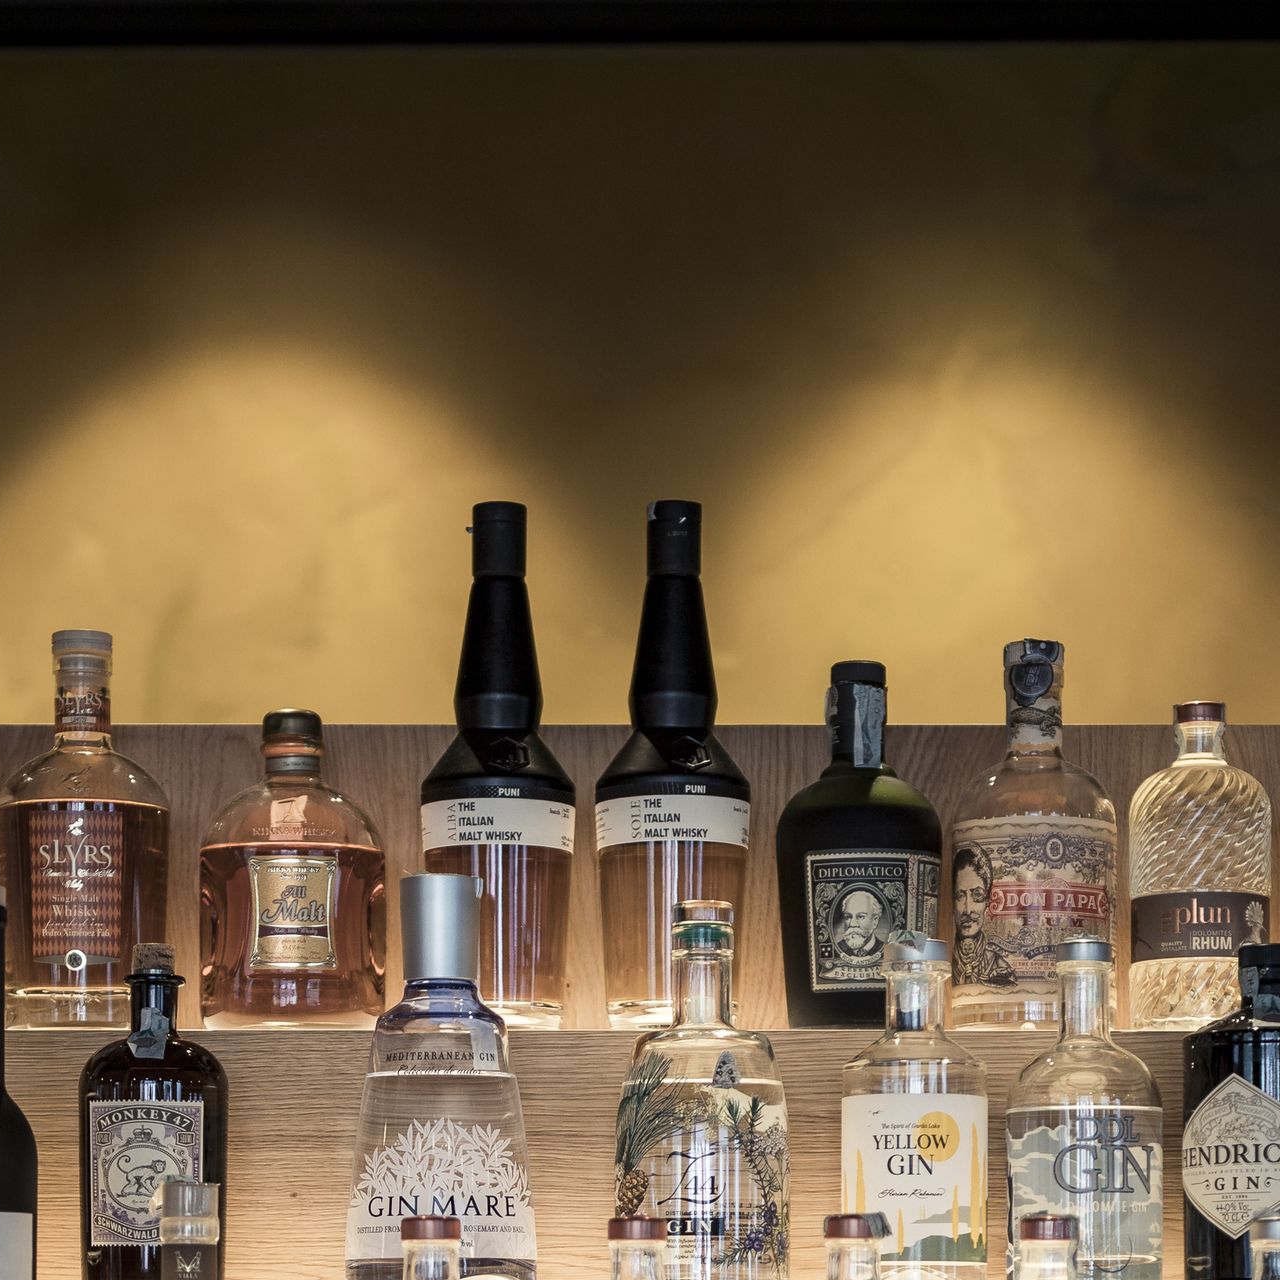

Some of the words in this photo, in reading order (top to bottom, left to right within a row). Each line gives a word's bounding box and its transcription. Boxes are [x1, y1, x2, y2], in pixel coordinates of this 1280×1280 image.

[498, 787, 520, 797] PUNI
[684, 784, 707, 794] PUNI
[458, 802, 476, 812] THE
[643, 798, 662, 808] THE
[447, 802, 458, 842] ALBA
[458, 816, 494, 827] ITALIAN
[630, 800, 642, 840] SOLE
[644, 813, 681, 824] ITALIAN
[459, 831, 483, 842] MALT
[485, 831, 523, 842] WHISKY
[644, 828, 670, 839] MALT
[672, 828, 709, 838] WHISKY
[38, 834, 113, 878] SLYRS
[818, 864, 903, 878] DIPLOMÁTICO
[280, 884, 307, 901] All
[1005, 892, 1047, 907] DON
[1052, 892, 1097, 910] PAPA
[51, 904, 99, 918] Whisky
[261, 899, 326, 925] Malt
[1173, 897, 1231, 934] plun
[1192, 929, 1233, 937] DOLOMITES
[1192, 936, 1233, 950] RHUM
[385, 1052, 475, 1063] MEDITERRANEAN
[478, 1052, 496, 1062] GIN
[100, 1107, 172, 1129] MONKEY
[172, 1114, 192, 1127] 47
[1075, 1114, 1141, 1144] DOL
[872, 1133, 951, 1151] YELLOW
[886, 1153, 935, 1177] GIN
[1052, 1143, 1155, 1195] GIN
[1214, 1175, 1261, 1191] GIN
[368, 1194, 420, 1218] GIN
[431, 1194, 517, 1219] MARE
[1131, 1201, 1147, 1213] GIN
[96, 1216, 158, 1239] SCHWARZWALD
[357, 1226, 384, 1235] DISTILLED
[463, 1225, 499, 1234] ROSEMARY
[499, 1225, 512, 1233] AND
[666, 1219, 714, 1234] GIN
